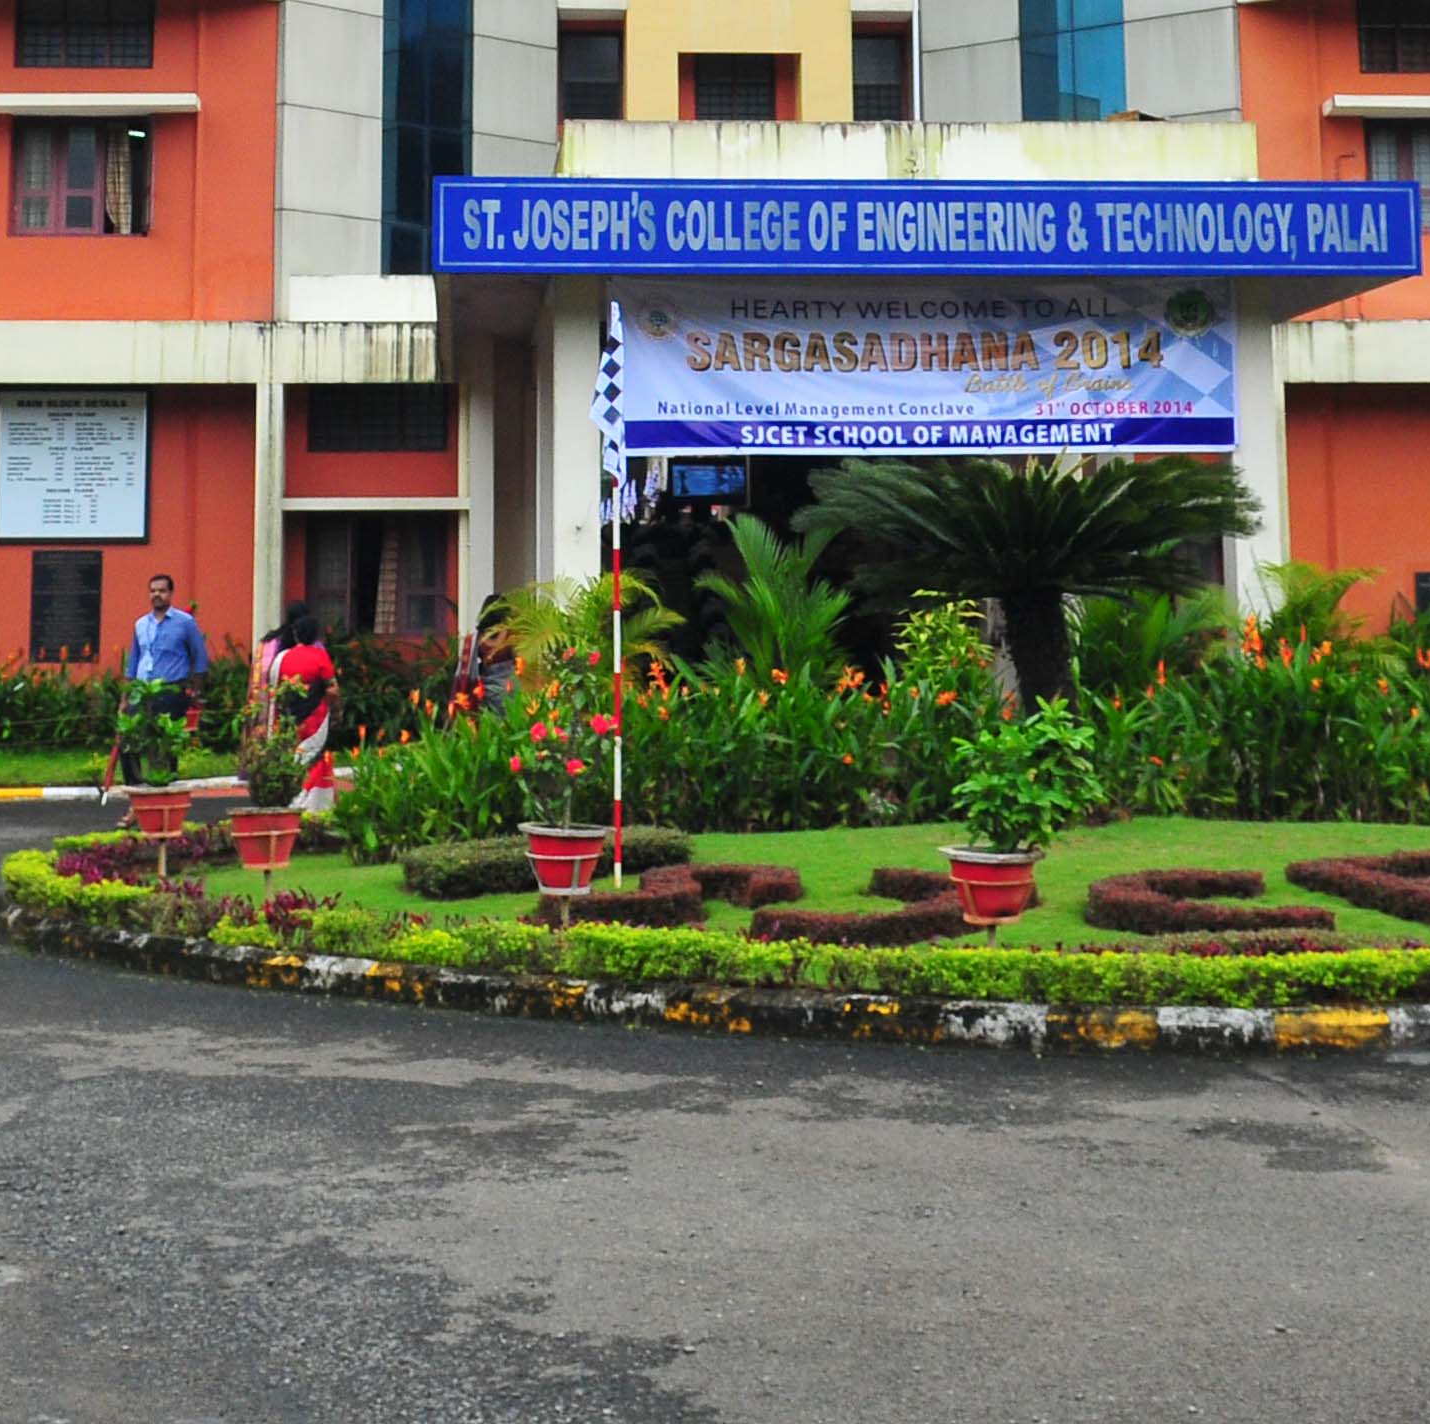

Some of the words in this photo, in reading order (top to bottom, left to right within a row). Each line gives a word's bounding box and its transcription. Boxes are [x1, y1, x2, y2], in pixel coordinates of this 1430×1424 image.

[462, 199, 505, 251] ST.
[513, 191, 657, 252] JOSEPH'S
[665, 200, 801, 252] COLLEGE
[808, 200, 847, 252] OF
[857, 201, 1056, 253] ENGINEERING
[1067, 201, 1089, 253] &
[1096, 202, 1297, 262] TECHNOLOGY,
[1306, 203, 1388, 253] PALAI
[731, 299, 845, 319] HEARTY
[855, 299, 1016, 319] WELCOME
[1020, 298, 1053, 318] TO
[1066, 297, 1117, 317] ALL
[685, 330, 1040, 372] SARGASADHANA
[1053, 330, 1164, 371] 2014
[657, 401, 730, 415] National
[735, 401, 780, 415] Level
[784, 402, 893, 418] Management
[899, 402, 975, 416] Conclave
[1035, 401, 1065, 416] 31
[1070, 401, 1148, 415] OCTOBER
[1153, 400, 1193, 414] 2014
[741, 426, 808, 445] SJCET
[814, 425, 907, 445] SCHOOL
[913, 425, 943, 444] OF
[949, 423, 1116, 445] MANAGEMENT
